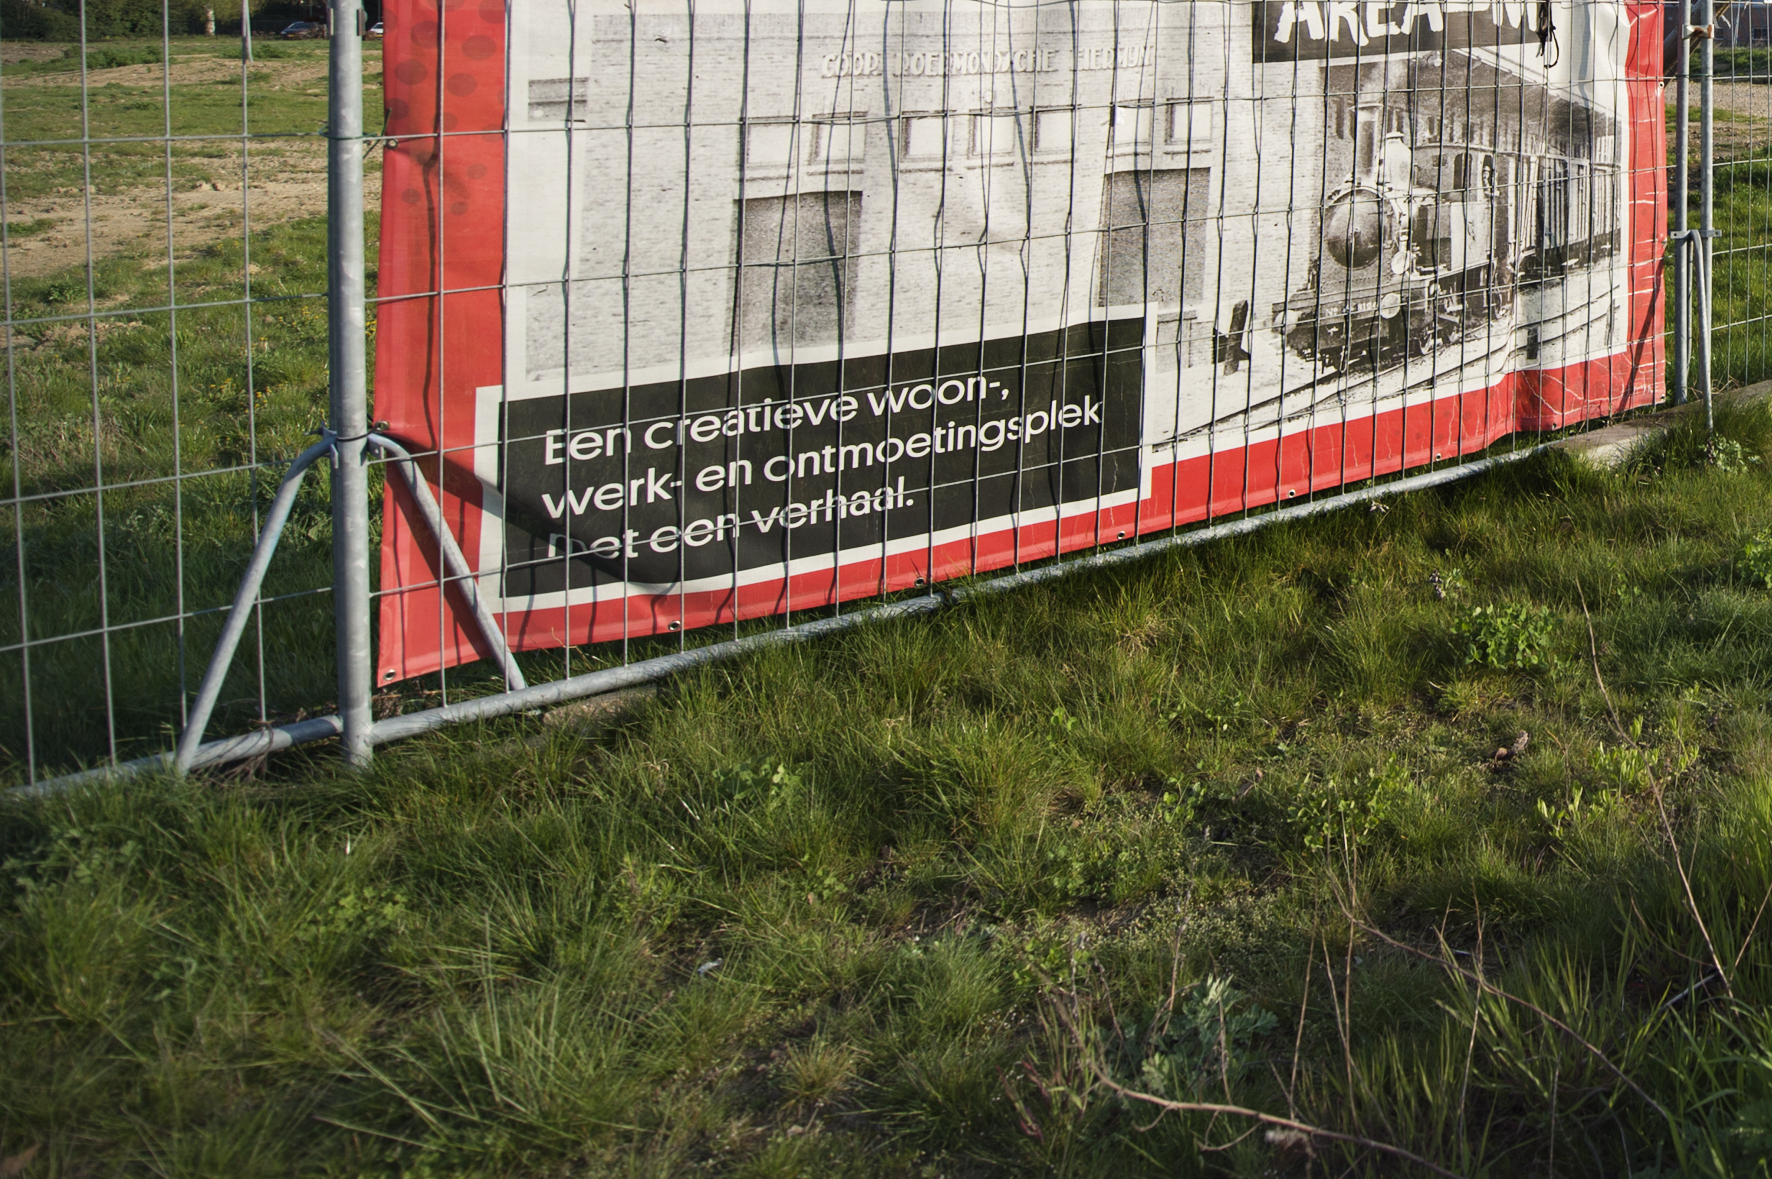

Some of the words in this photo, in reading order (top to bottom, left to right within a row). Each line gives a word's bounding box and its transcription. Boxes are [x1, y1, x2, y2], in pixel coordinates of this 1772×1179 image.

[542, 468, 682, 519] werk-
[696, 459, 752, 492] en
[764, 395, 1104, 481] ontmoetingsplek
[545, 427, 632, 465] Een
[644, 394, 859, 449] creatieve
[867, 376, 1009, 417] woon-,
[650, 513, 740, 553] een
[751, 476, 914, 533] verhaal.
